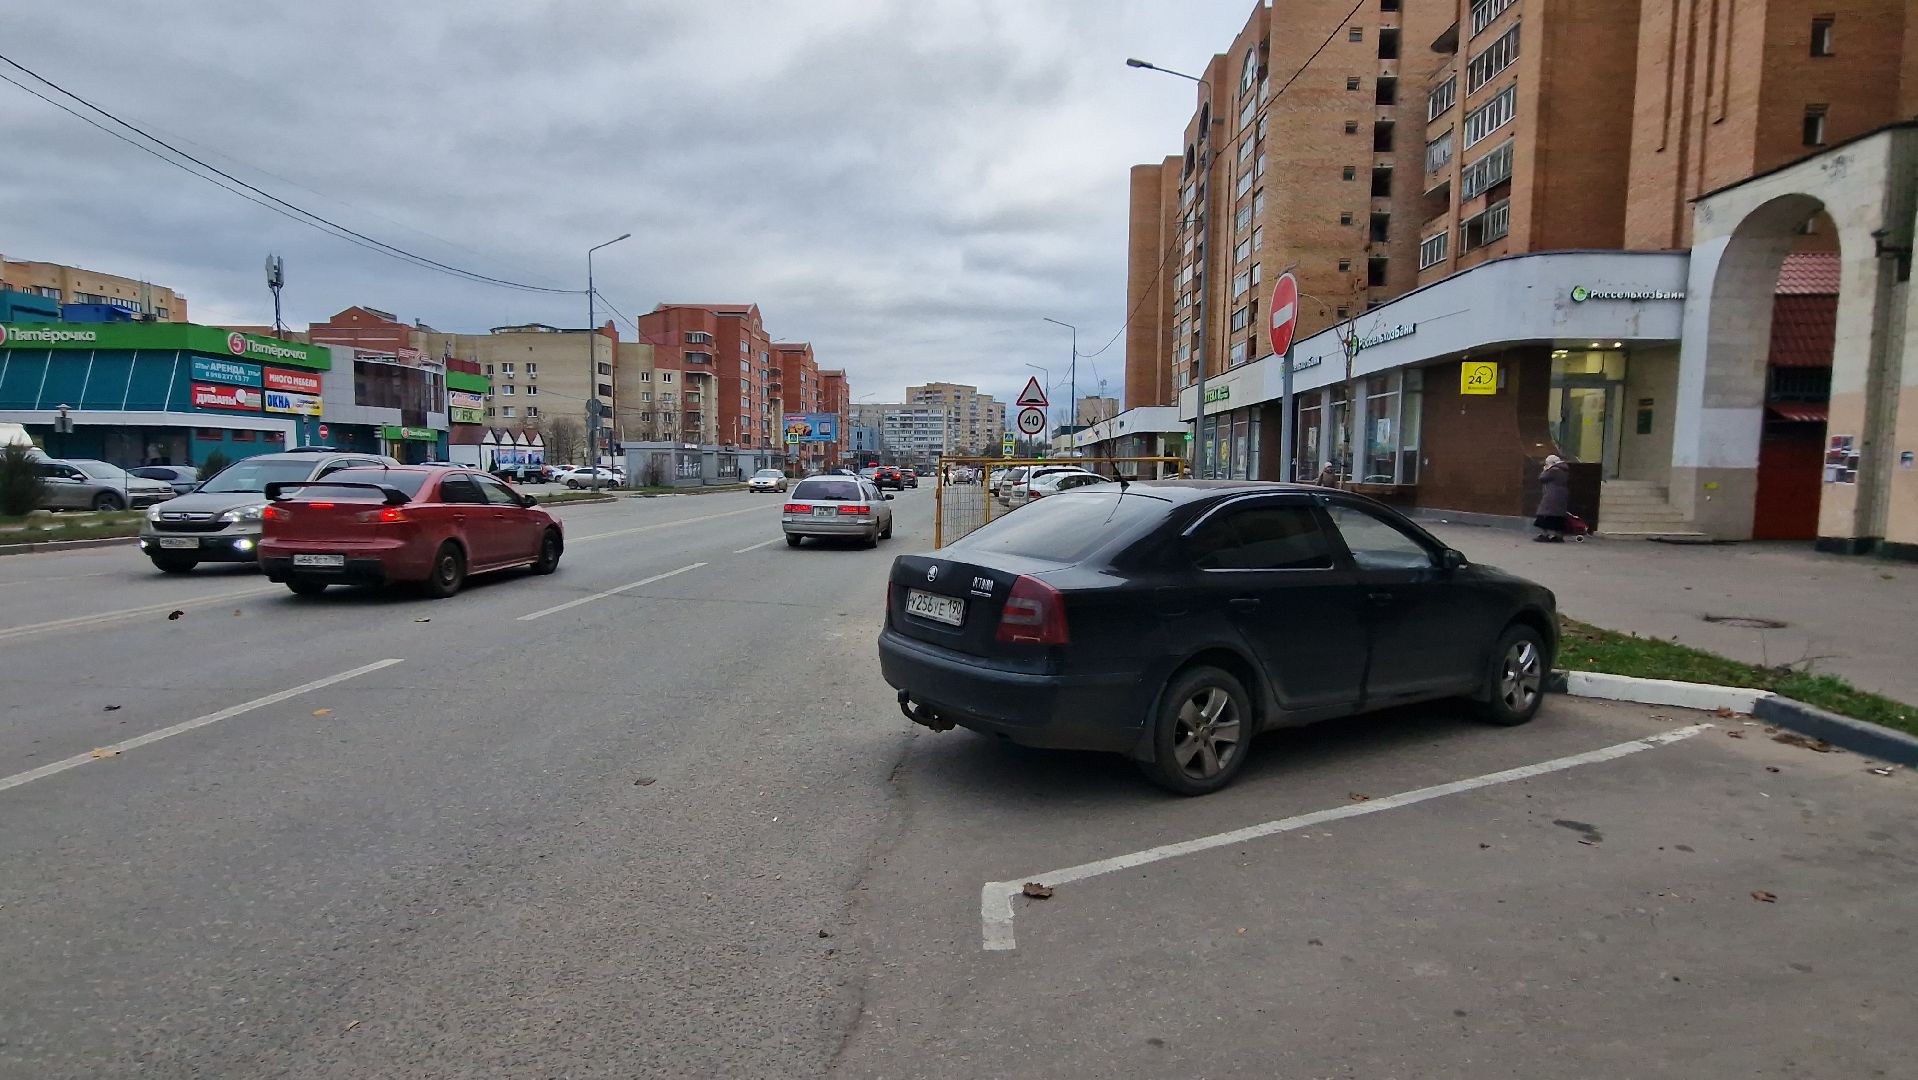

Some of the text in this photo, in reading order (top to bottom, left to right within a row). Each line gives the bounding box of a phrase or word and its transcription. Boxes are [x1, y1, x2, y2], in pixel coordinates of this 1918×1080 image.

[210, 362, 245, 375] АРЕНДА
[269, 373, 293, 385] МНОГО
[1468, 375, 1482, 385] 24
[267, 394, 290, 409] ОКНА
[1024, 415, 1039, 427] 40
